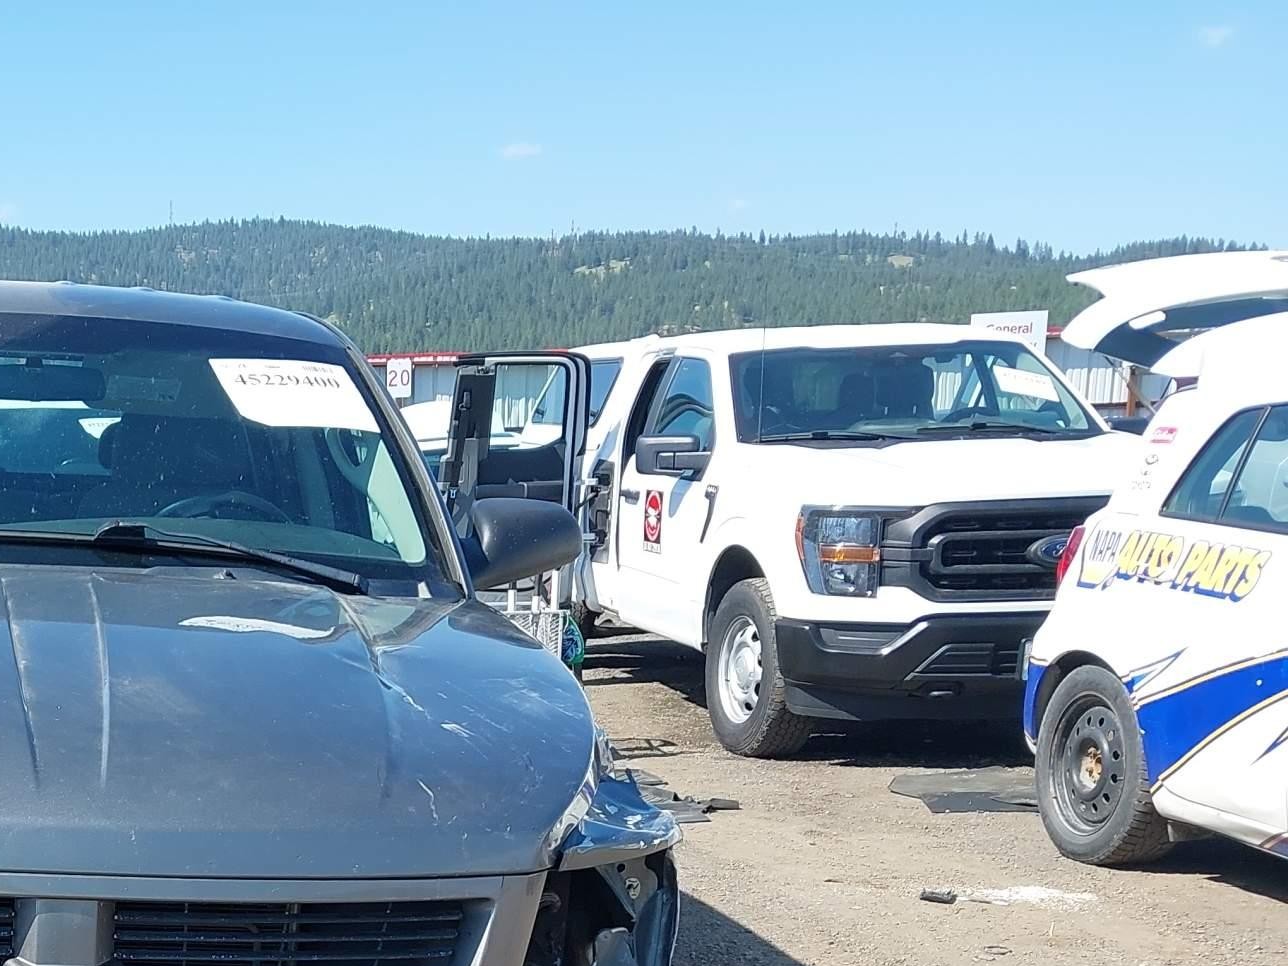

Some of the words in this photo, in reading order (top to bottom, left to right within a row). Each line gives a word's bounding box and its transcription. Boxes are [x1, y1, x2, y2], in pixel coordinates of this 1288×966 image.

[987, 322, 1032, 334] eneral
[234, 373, 341, 389] 45229400
[389, 370, 410, 387] 20
[1089, 529, 1122, 563] NAPA
[1115, 530, 1184, 583] AUTO
[1170, 539, 1272, 602] PARTS
